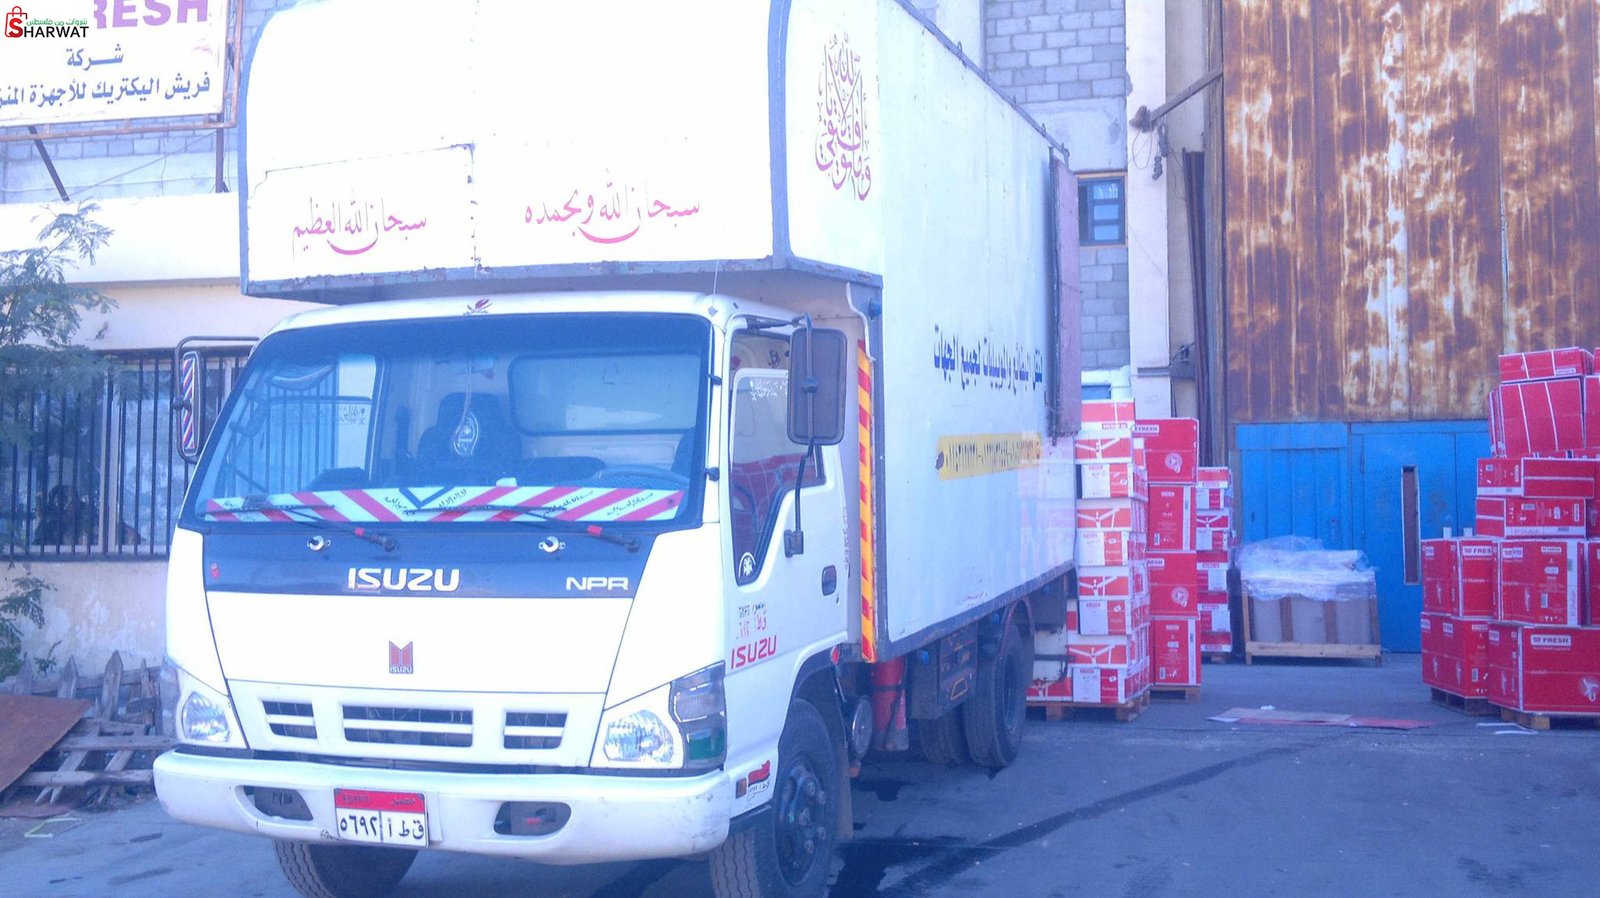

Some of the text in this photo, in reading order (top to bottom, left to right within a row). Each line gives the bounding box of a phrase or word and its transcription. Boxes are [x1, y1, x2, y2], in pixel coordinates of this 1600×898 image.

[66, 44, 124, 72] شركة
[0, 71, 211, 109] فريش اليكتريك للأجهزة المن
[292, 196, 342, 258] العظيم
[933, 322, 960, 384] الجهات
[961, 340, 981, 391] لجميع
[348, 567, 632, 592] ISUZU NPR
[731, 635, 777, 670] ISUZU
[339, 814, 377, 837] ٥٦٩٢
[398, 820, 410, 837] ط
[412, 819, 424, 839] ق
